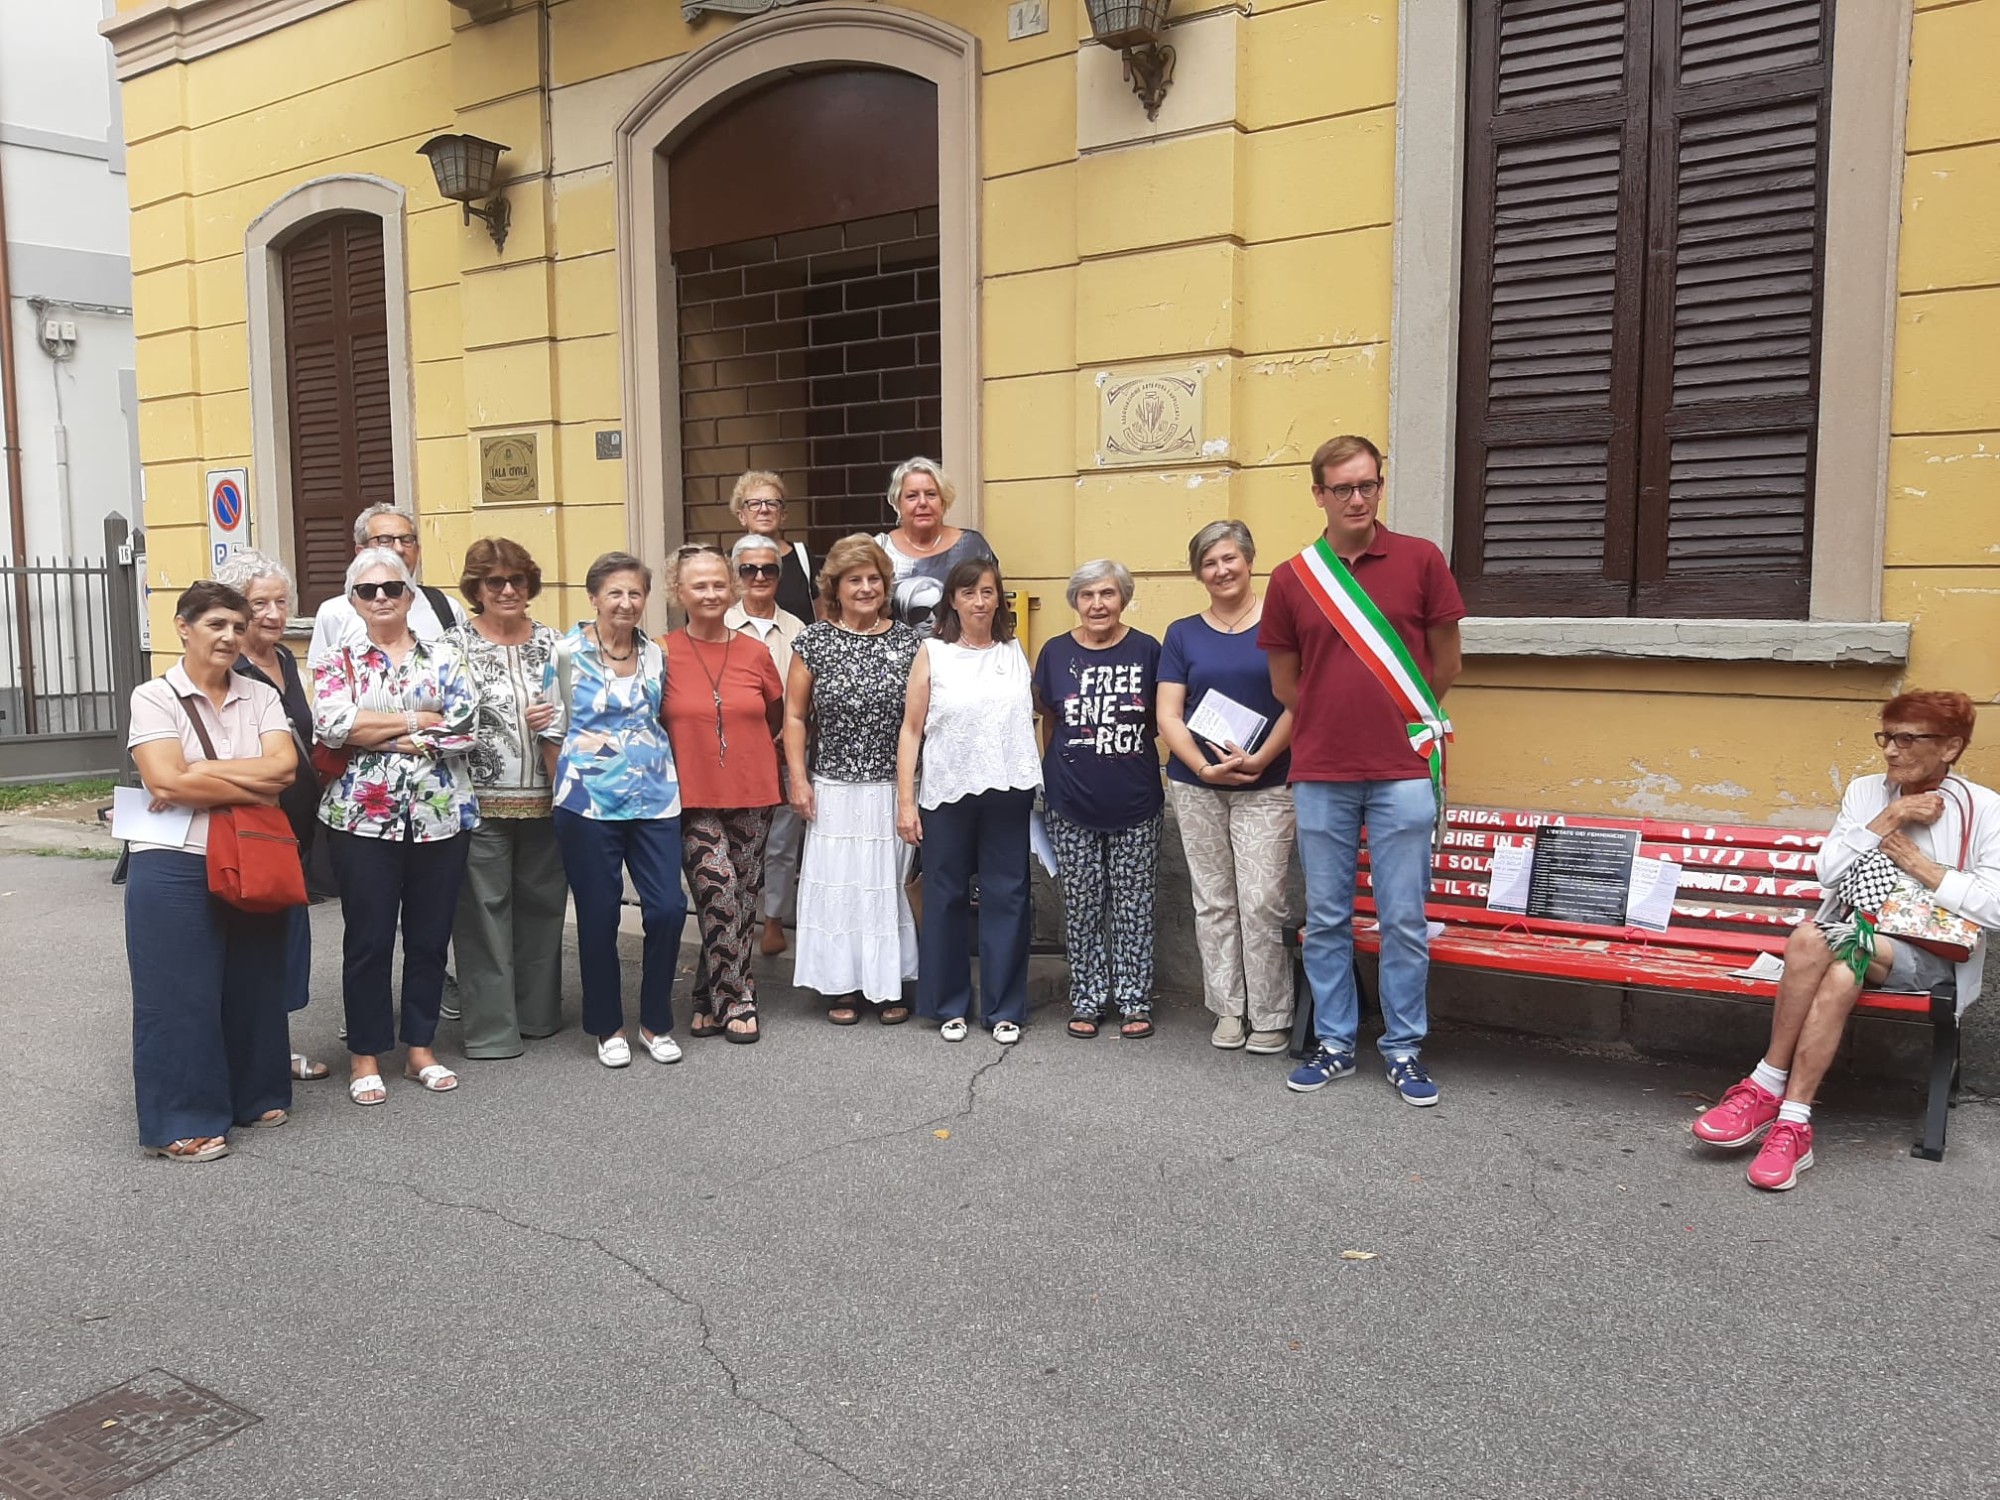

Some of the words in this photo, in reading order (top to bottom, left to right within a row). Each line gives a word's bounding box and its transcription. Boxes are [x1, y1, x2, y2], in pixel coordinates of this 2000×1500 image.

[1016, 4, 1040, 31] 14
[120, 548, 129, 561] 16
[1080, 664, 1143, 696] FREE
[1446, 809, 1506, 827] GRIDA,
[1515, 813, 1566, 827] URLA
[1445, 880, 1462, 895] IL
